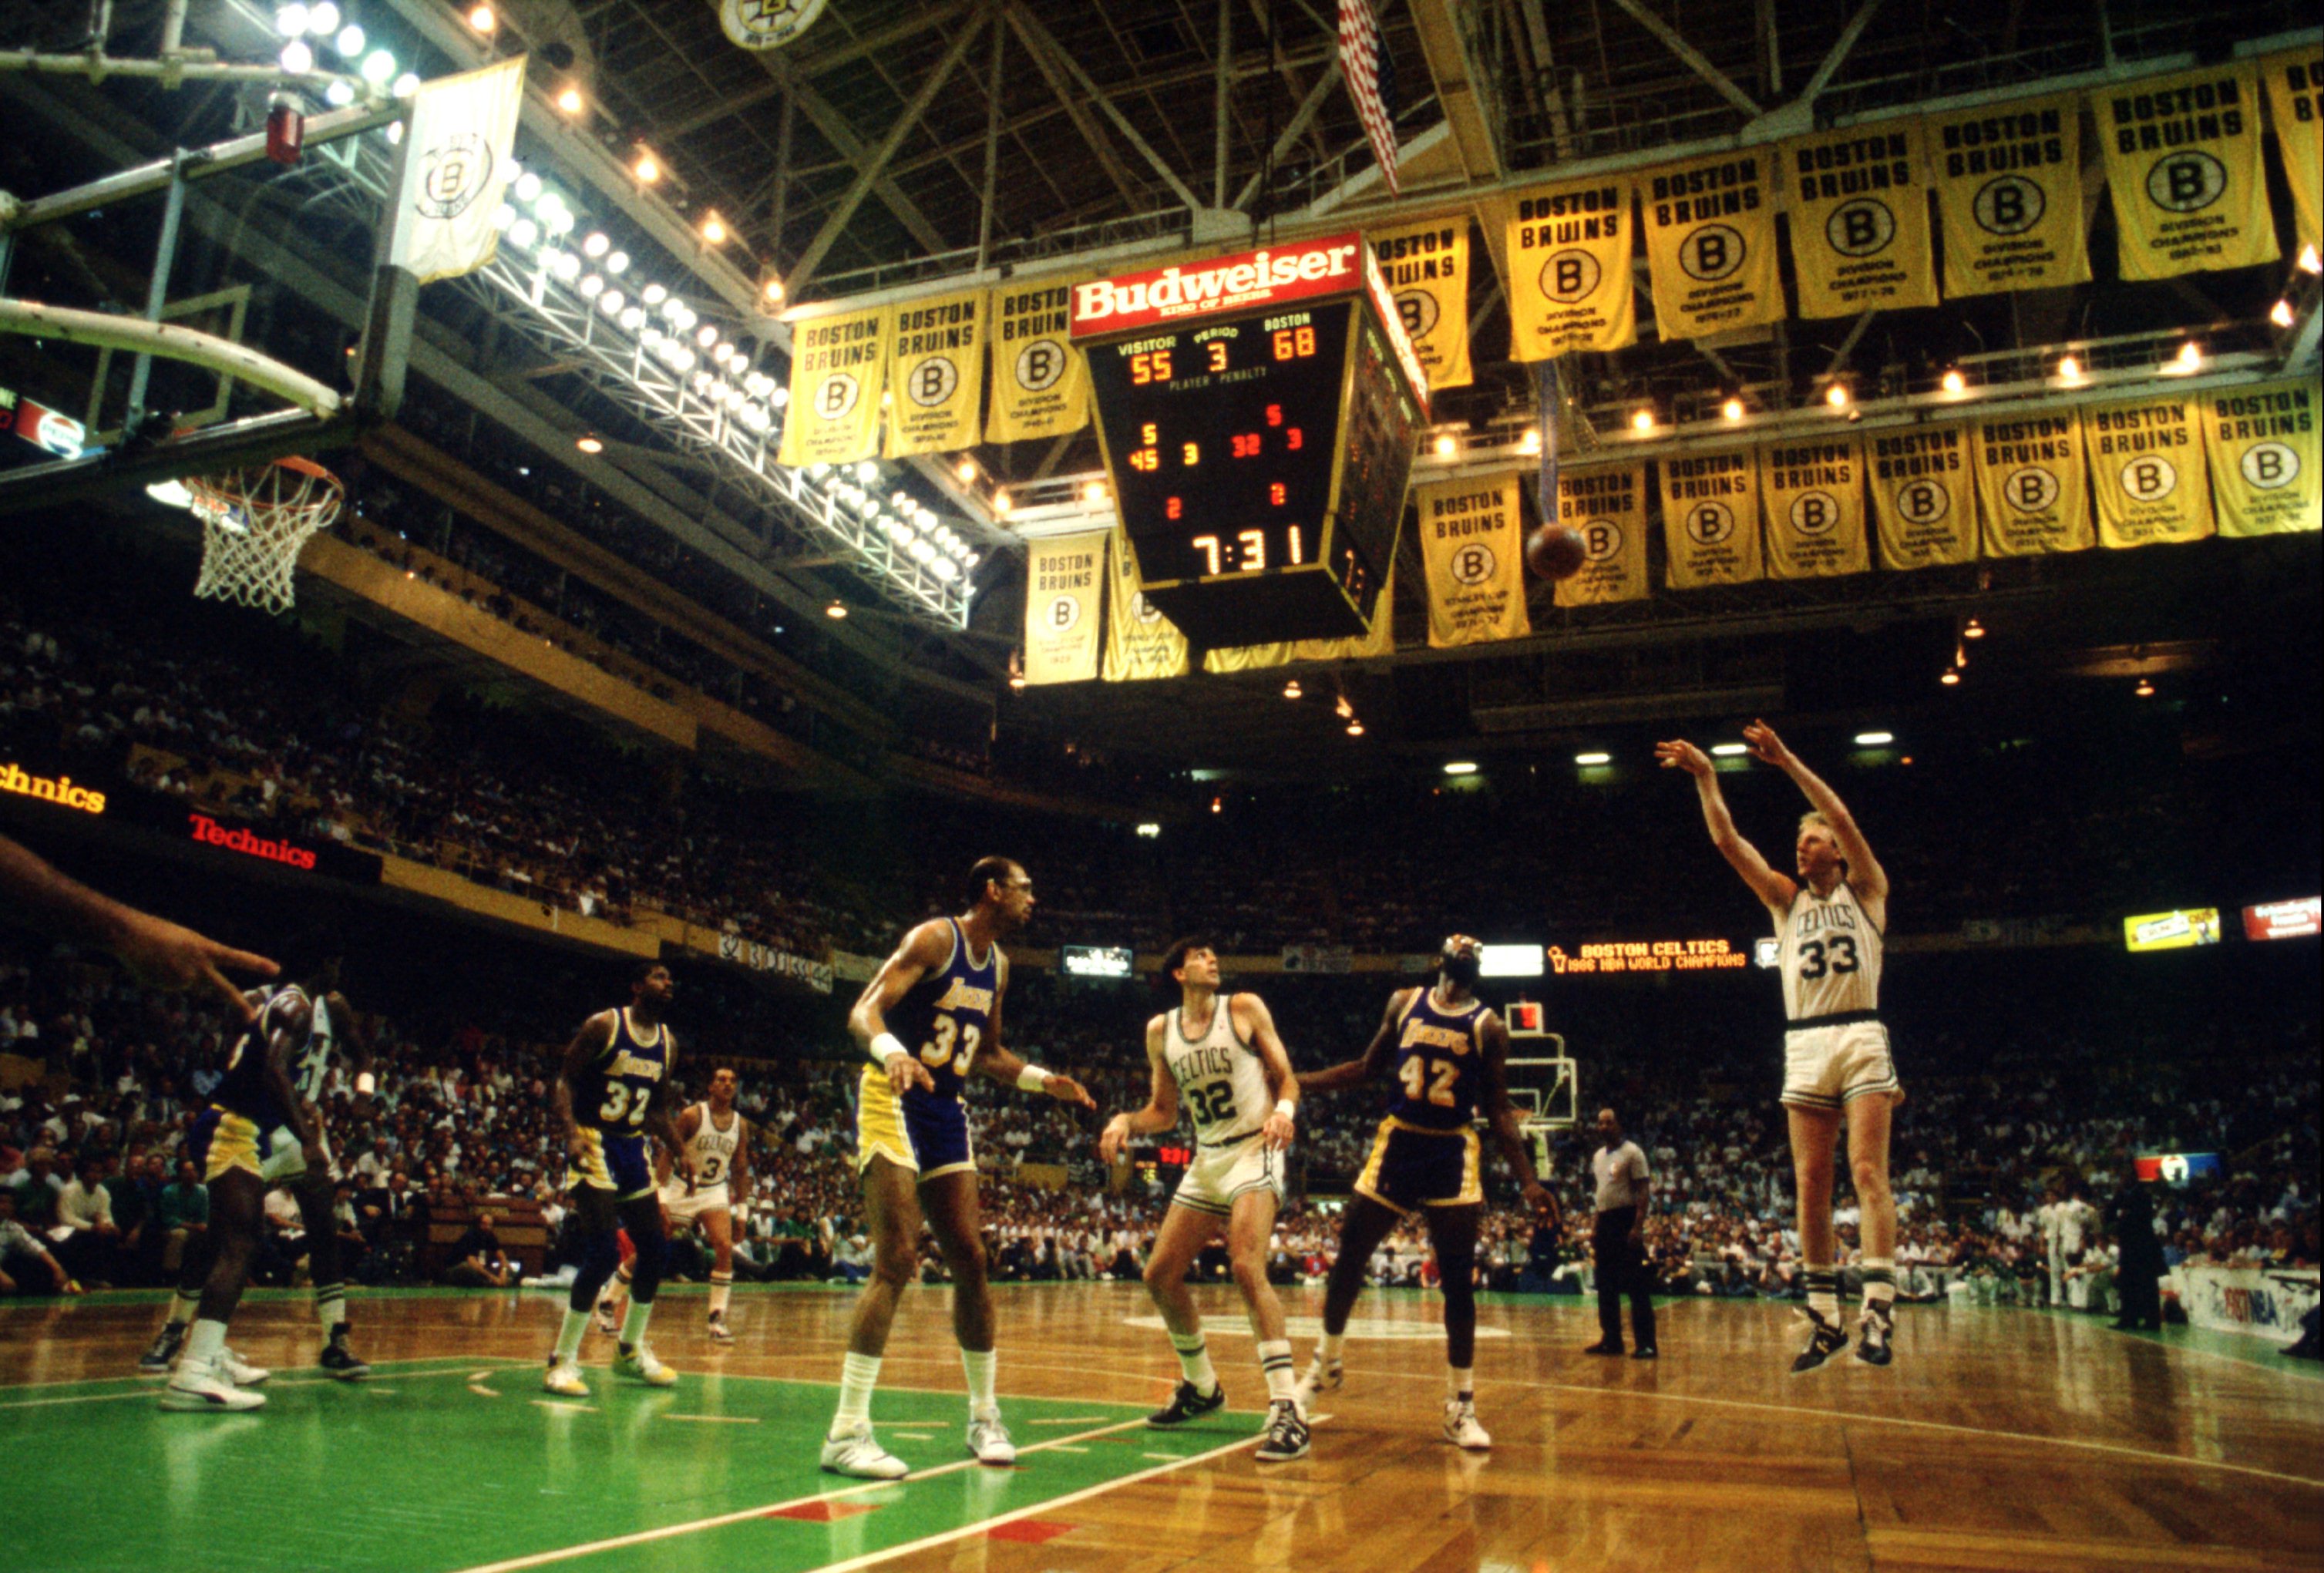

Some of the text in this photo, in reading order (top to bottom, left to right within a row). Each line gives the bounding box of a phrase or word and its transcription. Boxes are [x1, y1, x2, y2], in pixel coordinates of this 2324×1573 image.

[2114, 79, 2238, 124] BOSTON
[1944, 109, 2060, 149] BOSTON
[2118, 111, 2243, 155] BRUINS
[1799, 134, 1908, 173] BOSTON
[1948, 139, 2063, 178] BRUINS
[1653, 160, 1758, 201] BOSTON
[1801, 162, 1910, 201] BRUINS
[2169, 162, 2203, 202] B
[1521, 188, 1618, 222] BOSTON
[1657, 187, 1760, 227] BRUINS
[1994, 187, 2024, 224] B
[1523, 216, 1618, 250] BRUINS
[1846, 210, 1876, 247] B
[1698, 235, 1727, 272] B
[1075, 245, 1356, 321] Budweiser
[1384, 257, 1455, 287] RUINS
[1558, 260, 1582, 294] B
[900, 301, 975, 331] BOSTON
[1005, 287, 1068, 317] BOSTO
[1160, 304, 1196, 317] KING
[1200, 298, 1219, 309] OF
[808, 318, 879, 348] BOSTON
[1005, 311, 1067, 341] BRUIN
[1194, 327, 1239, 343] PERIOD
[1264, 313, 1310, 331] BOSTON
[899, 325, 973, 358] BRUINS
[1118, 336, 1177, 356] VISITOR
[1208, 341, 1226, 371] 3
[1273, 326, 1315, 361] 68
[805, 343, 877, 371] BRUINS
[1029, 350, 1051, 382] B
[1131, 351, 1172, 385] 55
[923, 368, 943, 398] B
[1169, 366, 1266, 391] PLAYER PENALTY
[827, 382, 847, 412] B
[2217, 389, 2309, 418] BOSTON
[1266, 404, 1283, 426] 5
[2099, 405, 2186, 432] BOSTON
[2221, 413, 2312, 441] BRUINS
[1142, 423, 1157, 445] 5
[1287, 428, 1303, 449] 3
[1878, 431, 1959, 456] BOSTON
[1984, 418, 2067, 443] BOSTON
[2102, 428, 2188, 454] BRUINS
[1129, 448, 1159, 471] 45
[1182, 442, 1199, 466] 3
[1670, 454, 1744, 477] BOSTON
[1774, 444, 1850, 468] BOSTON
[1879, 452, 1959, 479] BRUINS
[1987, 440, 2070, 466] BRUINS
[2258, 450, 2282, 481] B
[1562, 474, 1633, 497] BOSTON
[1672, 476, 1747, 499] BRUINS
[1776, 466, 1850, 489] BRUINS
[2021, 476, 2043, 505] B
[2137, 464, 2161, 493] B
[1166, 496, 1182, 519] 2
[1434, 490, 1504, 517] BOSTON
[1563, 495, 1633, 518] BRUINS
[1804, 499, 1825, 528] B
[1912, 488, 1935, 517] B
[1438, 513, 1505, 538] BRUINS
[1700, 509, 1720, 536] B
[1590, 527, 1609, 553] B
[1040, 554, 1093, 573] BOSTON
[1464, 552, 1483, 577] B
[1040, 572, 1091, 591] BRUINS
[1055, 603, 1071, 626] B
[0, 764, 106, 814] chnics
[189, 814, 316, 869] Technics
[1797, 904, 1855, 937] CELTICS
[1569, 953, 1746, 973] 1986 NBA WORLD CHAMPIONS
[1581, 939, 1730, 959] BOSTON CELTICS
[1798, 935, 1859, 980] 33
[920, 1013, 981, 1077] 33
[1172, 1047, 1233, 1087] CELTICS
[1399, 1054, 1460, 1107] 42
[600, 1081, 651, 1126] 32
[1189, 1080, 1237, 1125] 32
[702, 1157, 721, 1179] 3
